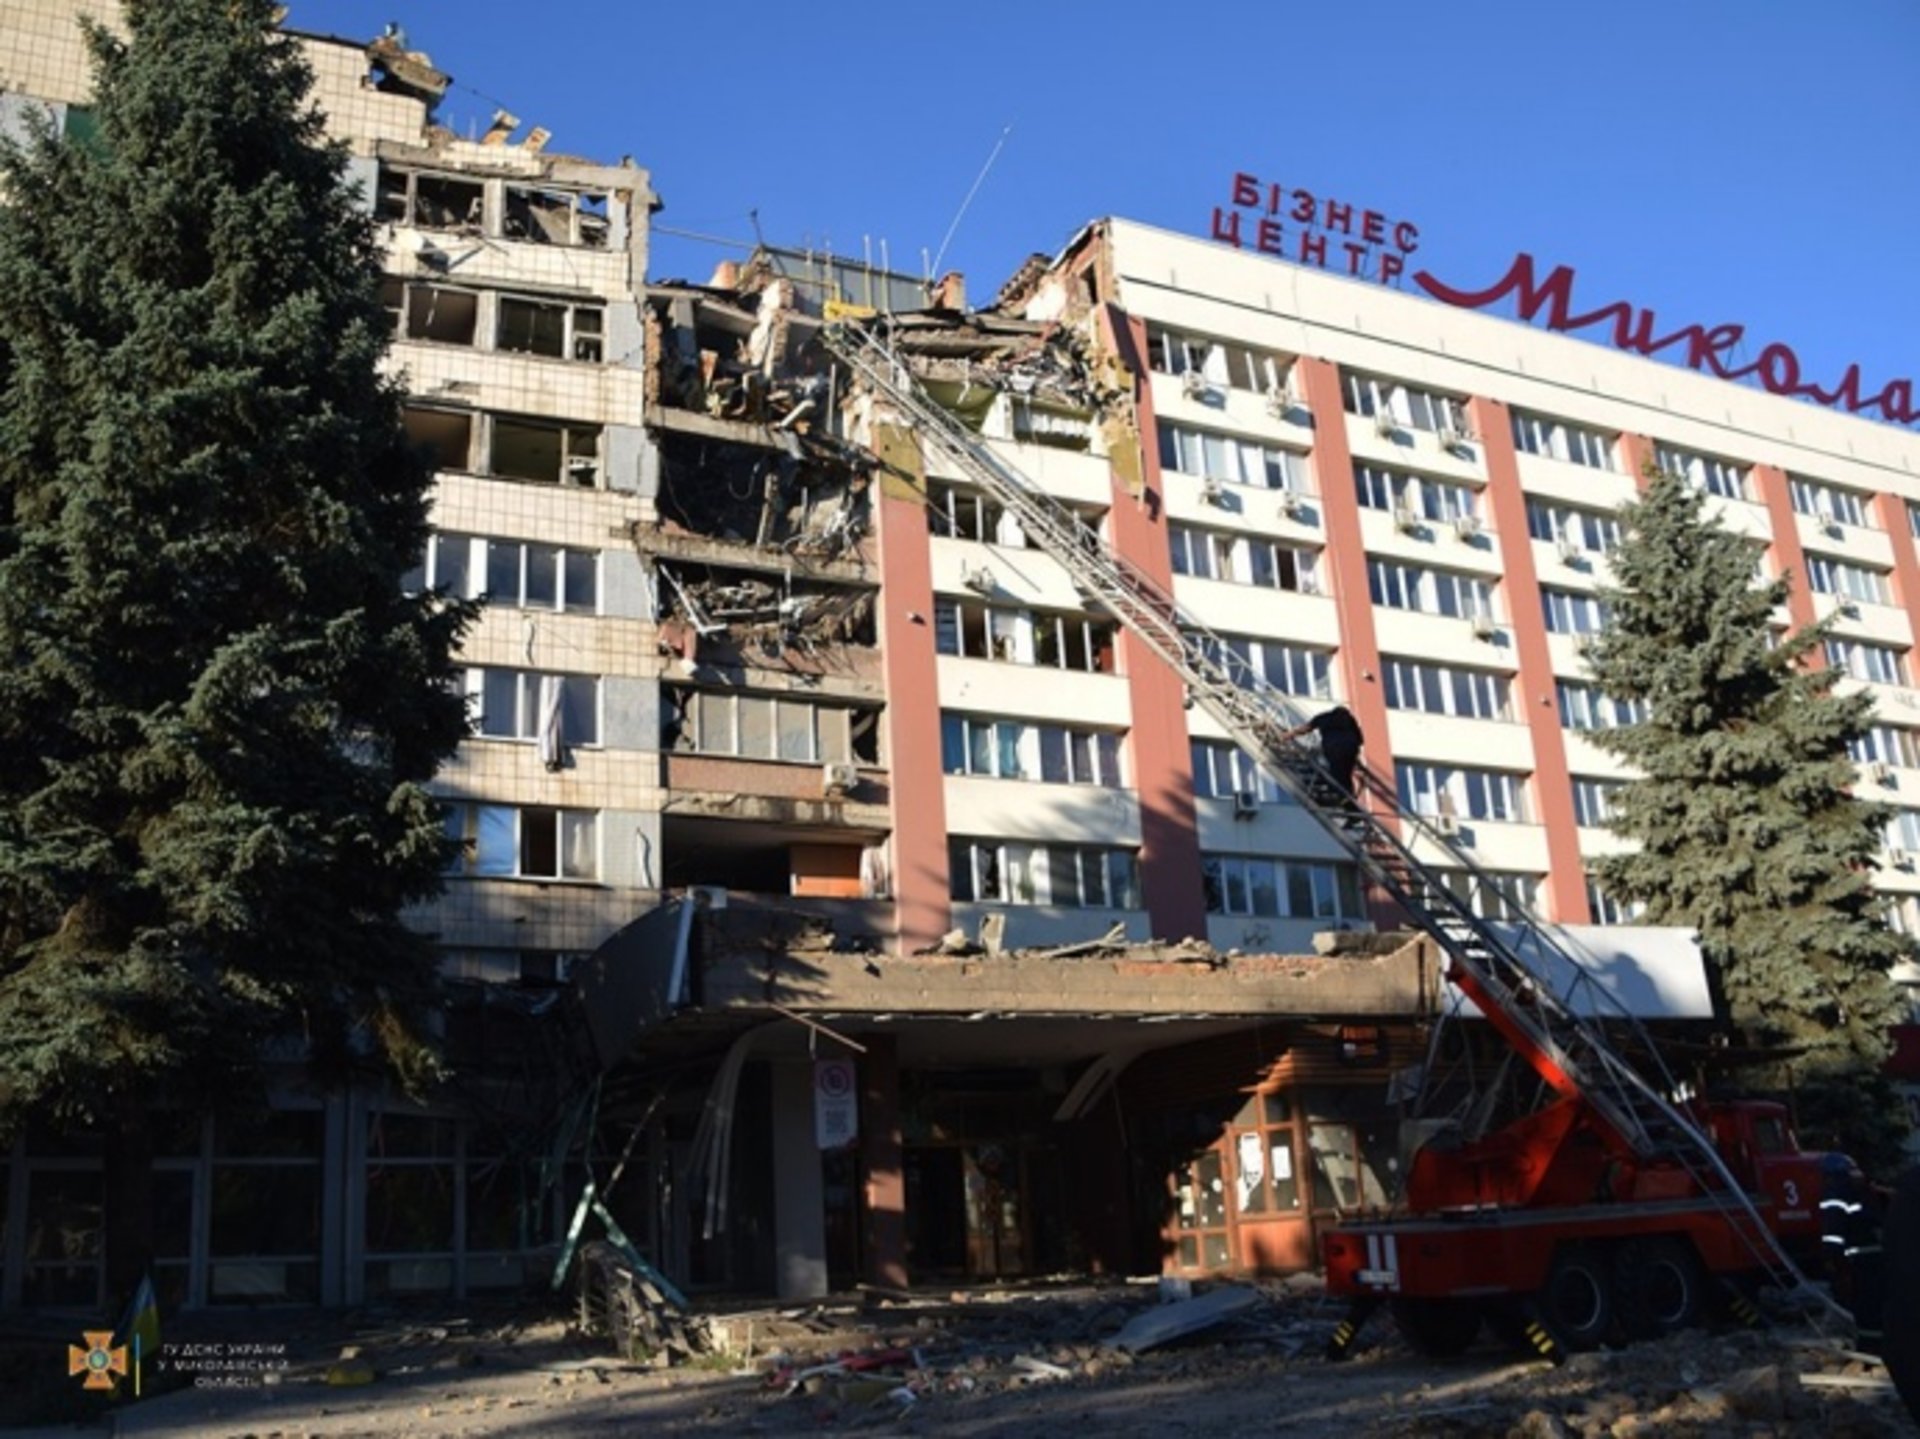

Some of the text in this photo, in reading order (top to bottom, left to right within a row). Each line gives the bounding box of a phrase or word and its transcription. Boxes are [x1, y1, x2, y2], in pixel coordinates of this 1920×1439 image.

[1212, 207, 1403, 284] ЦЕНТР
[1233, 172, 1419, 253] БІЗНЕС
[1783, 1179, 1799, 1206] 3
